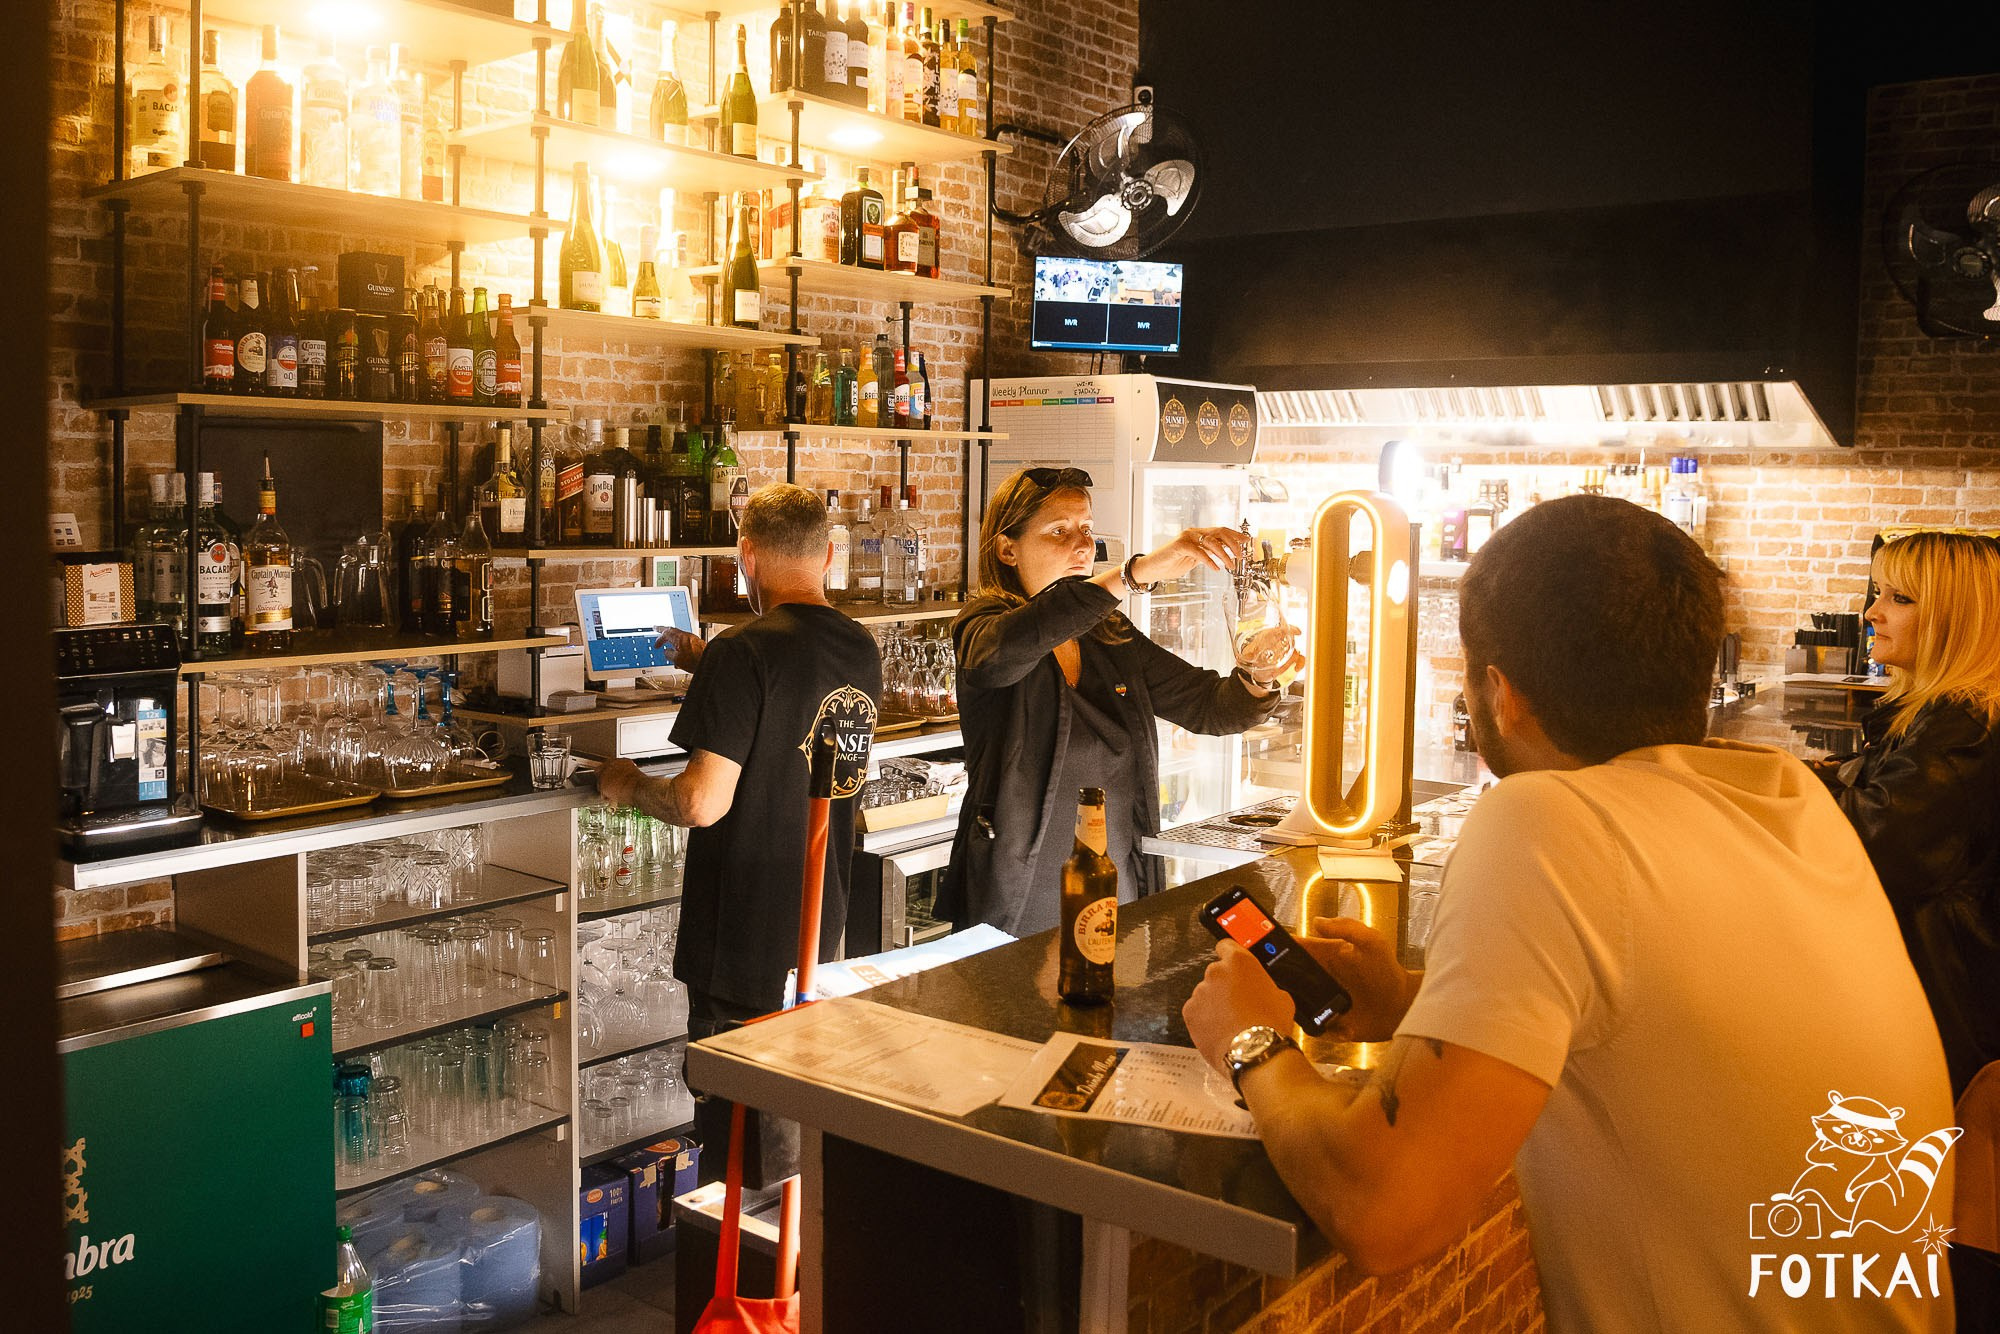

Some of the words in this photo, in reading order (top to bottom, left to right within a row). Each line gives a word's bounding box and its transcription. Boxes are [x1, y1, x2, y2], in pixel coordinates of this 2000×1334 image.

[367, 283, 395, 293] GUINNESS
[1064, 318, 1078, 327] NVR
[1137, 321, 1151, 330] NVR
[992, 386, 1016, 398] Weekly
[1019, 385, 1050, 397] Planner
[1165, 415, 1185, 425] SUNSET
[1200, 417, 1219, 427] SUNSET
[1230, 419, 1249, 429] SUNSET
[590, 482, 602, 495] JIM
[838, 719, 855, 728] THE
[836, 733, 875, 753] NSET
[1078, 903, 1104, 936] BIRRA
